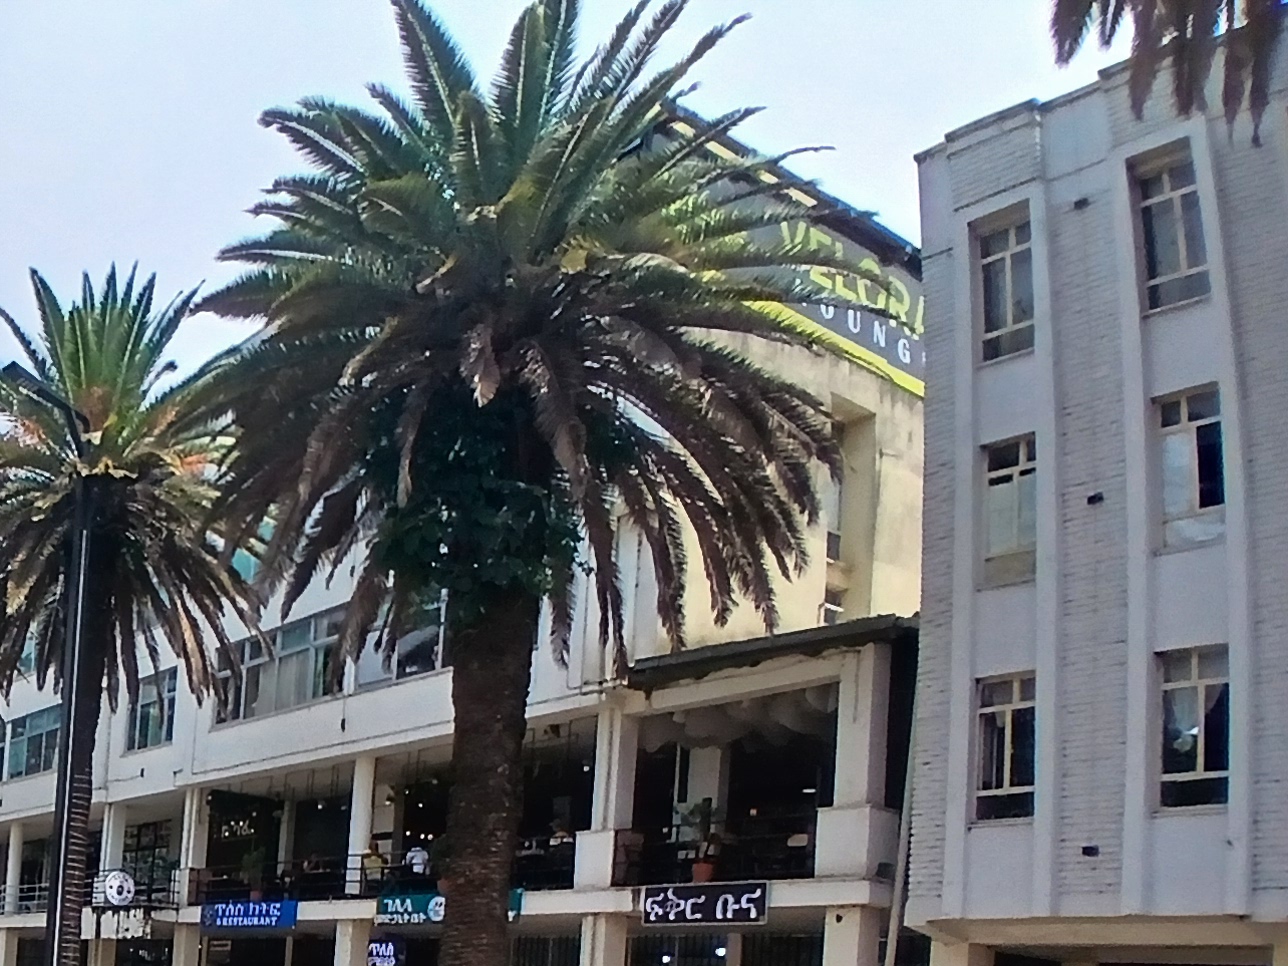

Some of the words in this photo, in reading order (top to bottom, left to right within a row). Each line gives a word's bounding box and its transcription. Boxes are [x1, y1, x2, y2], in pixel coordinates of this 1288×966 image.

[645, 888, 706, 921] ፍቅር
[715, 888, 762, 919] ቡና
[222, 916, 278, 926] RESTAURANT
